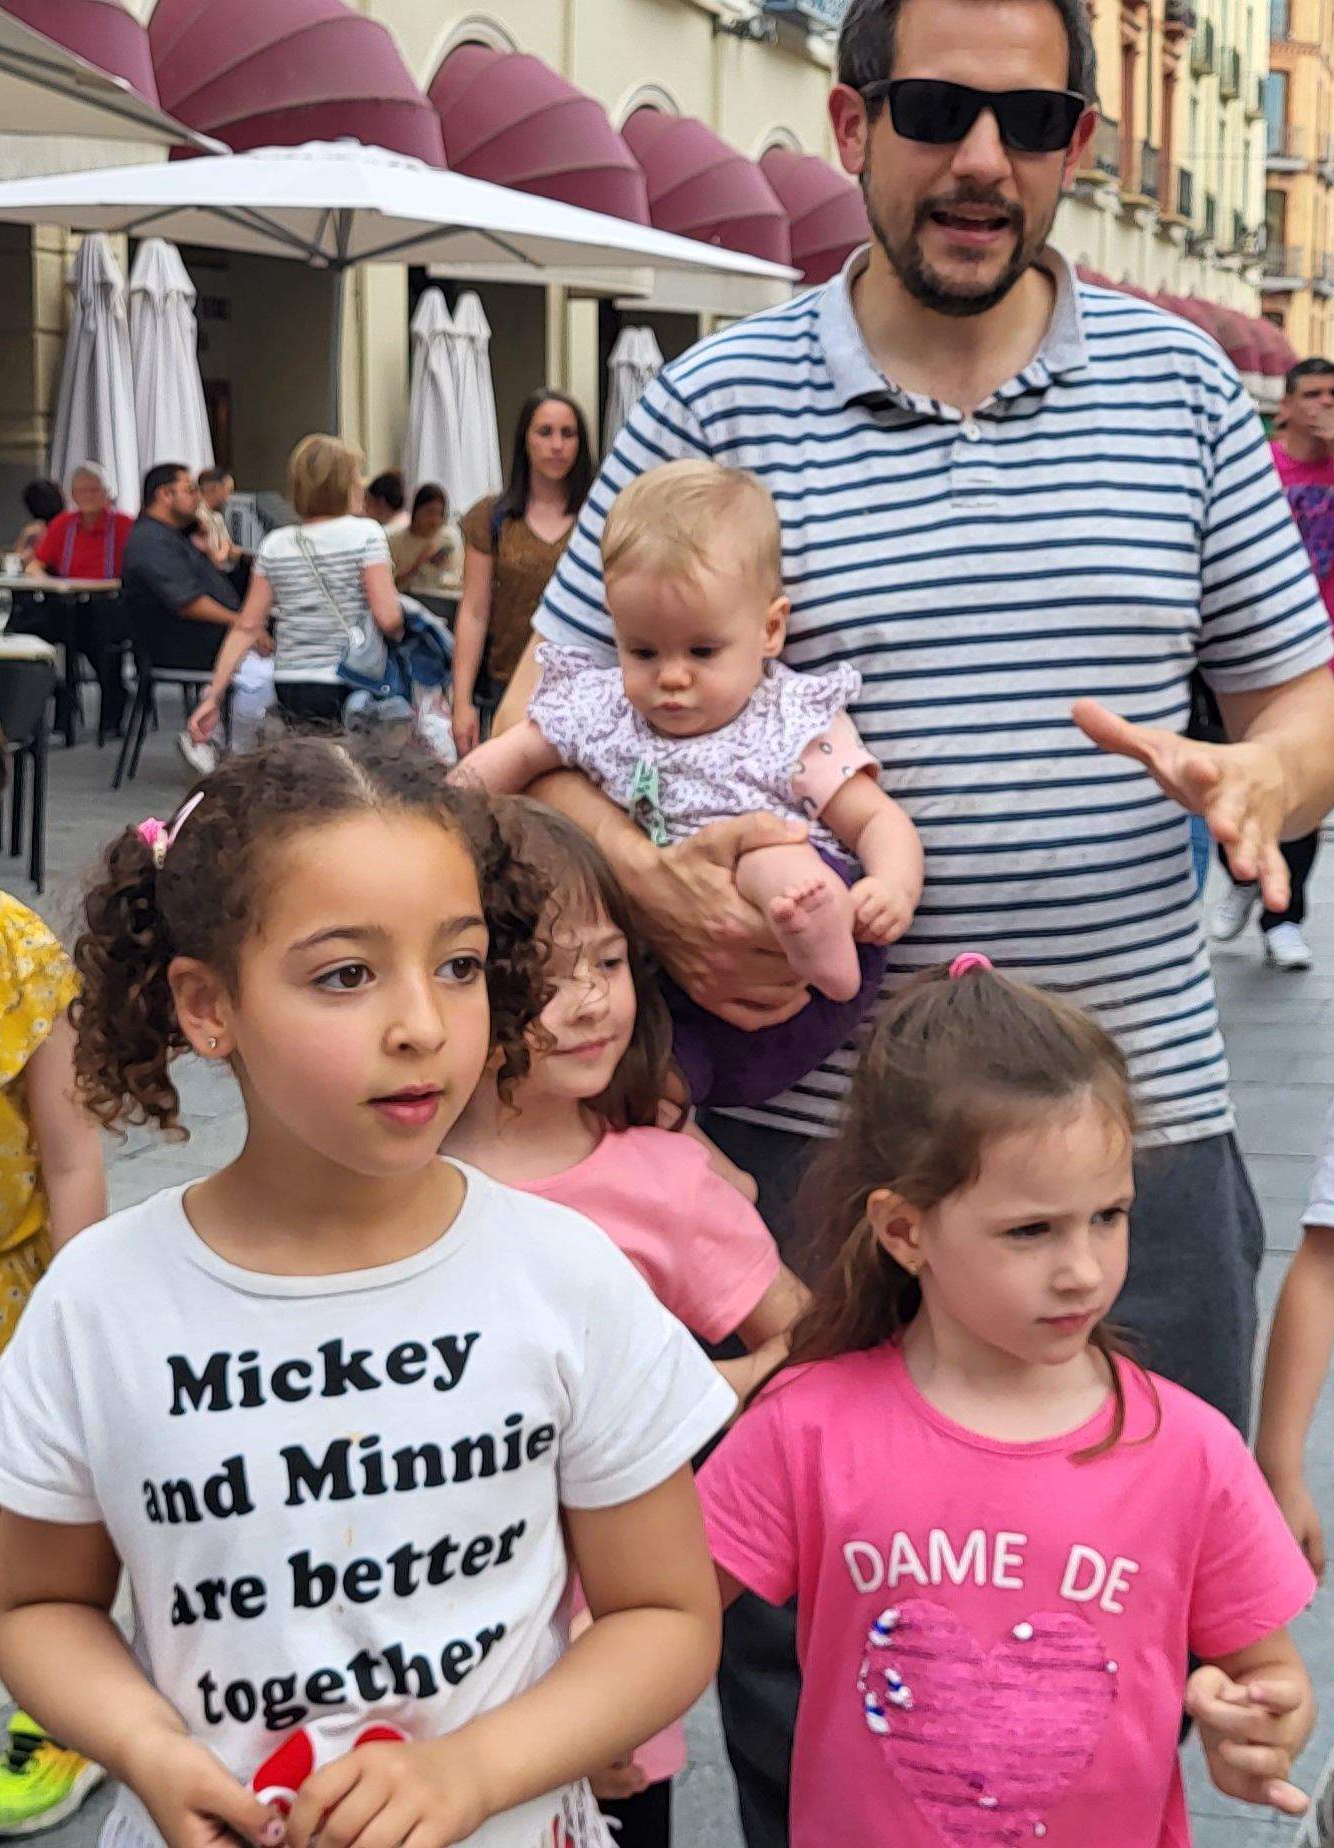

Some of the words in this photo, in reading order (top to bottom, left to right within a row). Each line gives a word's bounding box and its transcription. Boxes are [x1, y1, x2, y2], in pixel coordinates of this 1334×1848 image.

[166, 1331, 481, 1416] Mickey
[142, 1455, 255, 1524] and
[279, 1412, 557, 1507] Minnie
[171, 1574, 267, 1626] are
[287, 1518, 527, 1609] better
[842, 1528, 1029, 1594] DAME
[1059, 1543, 1140, 1614] DE
[197, 1621, 507, 1732] together
